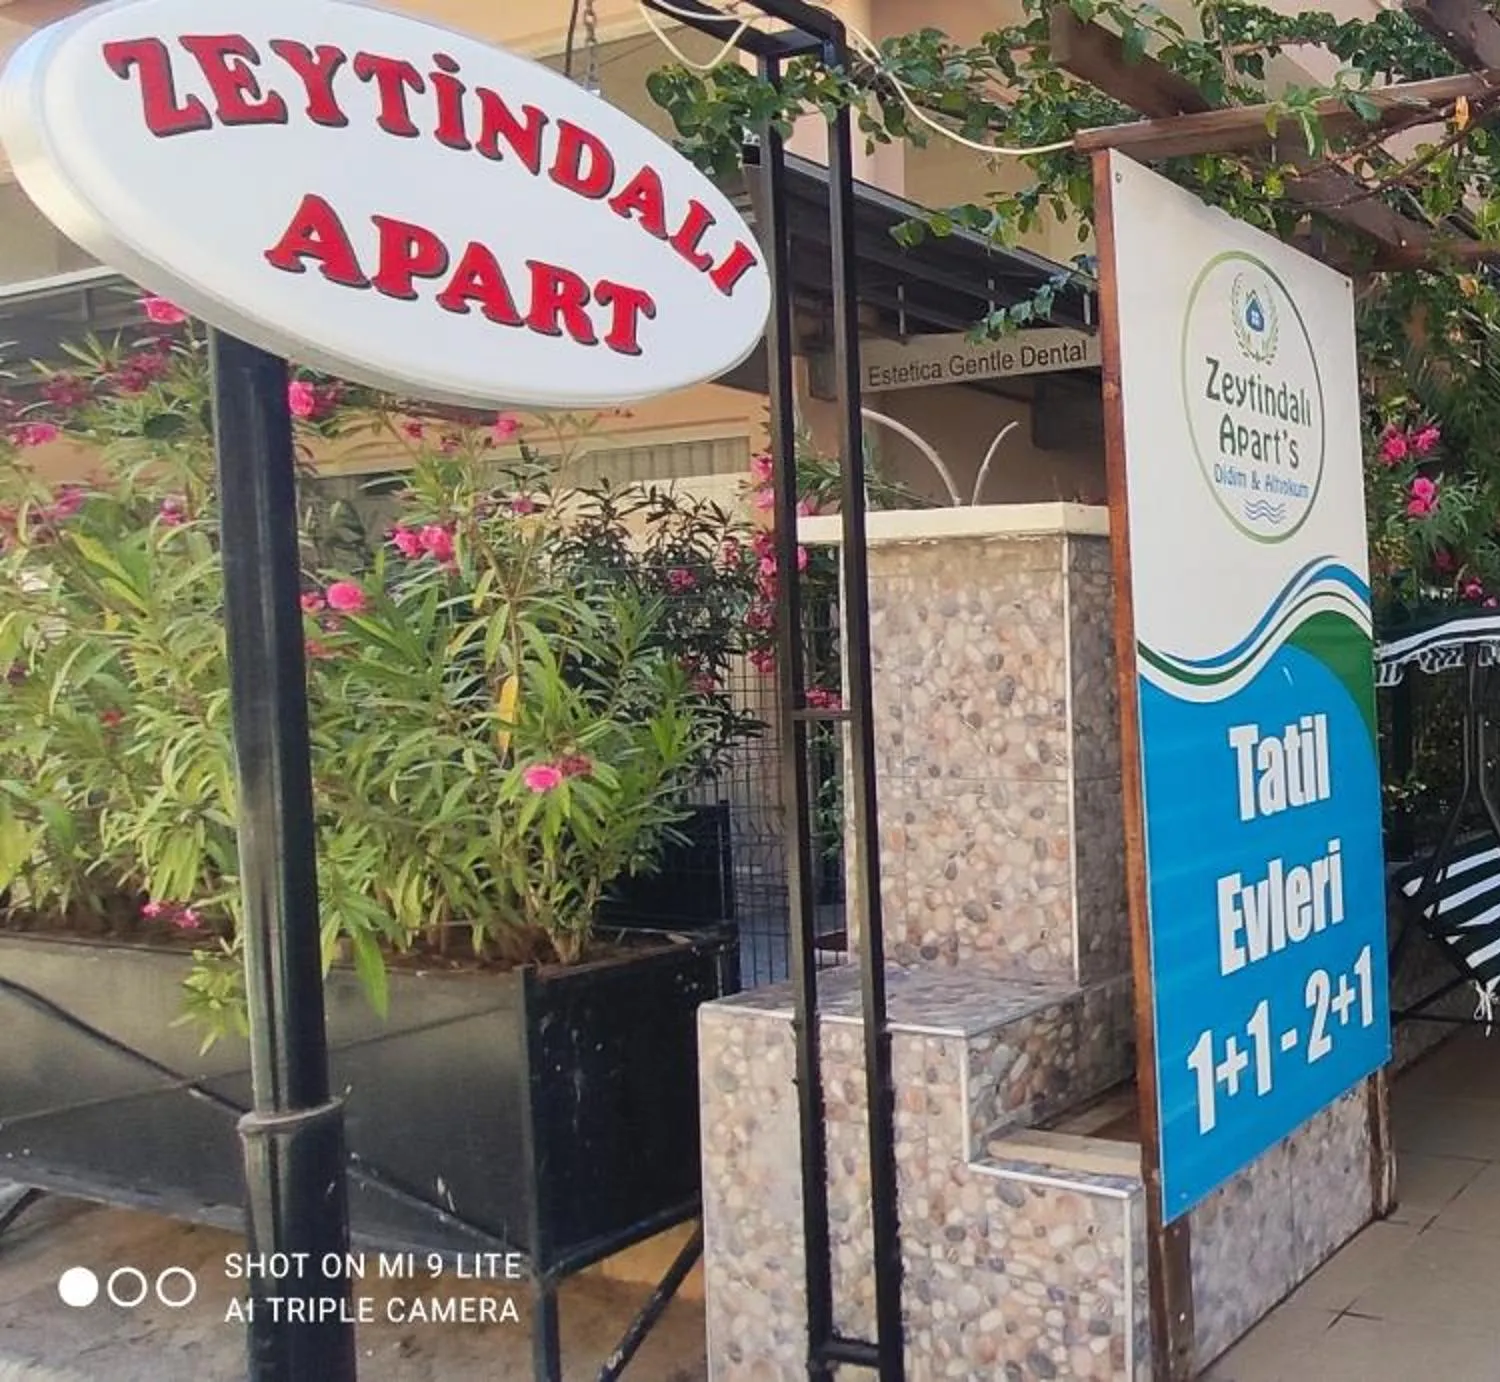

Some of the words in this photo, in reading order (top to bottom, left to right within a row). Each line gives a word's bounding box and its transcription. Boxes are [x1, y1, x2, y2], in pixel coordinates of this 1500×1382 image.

[103, 34, 757, 297] ZEYTİNDALI
[264, 193, 656, 355] APART
[868, 361, 943, 387] Estetica
[949, 352, 1015, 377] Gentle
[1021, 340, 1088, 367] Dental
[1214, 463, 1247, 488] Didim
[1251, 471, 1261, 490] &
[1219, 413, 1300, 469] Apart's
[1229, 713, 1331, 821] Tatil
[1217, 838, 1345, 976] Evleri
[1187, 999, 1273, 1136] 1+1
[1280, 1028, 1299, 1052] -
[1305, 945, 1374, 1065] 2+1
